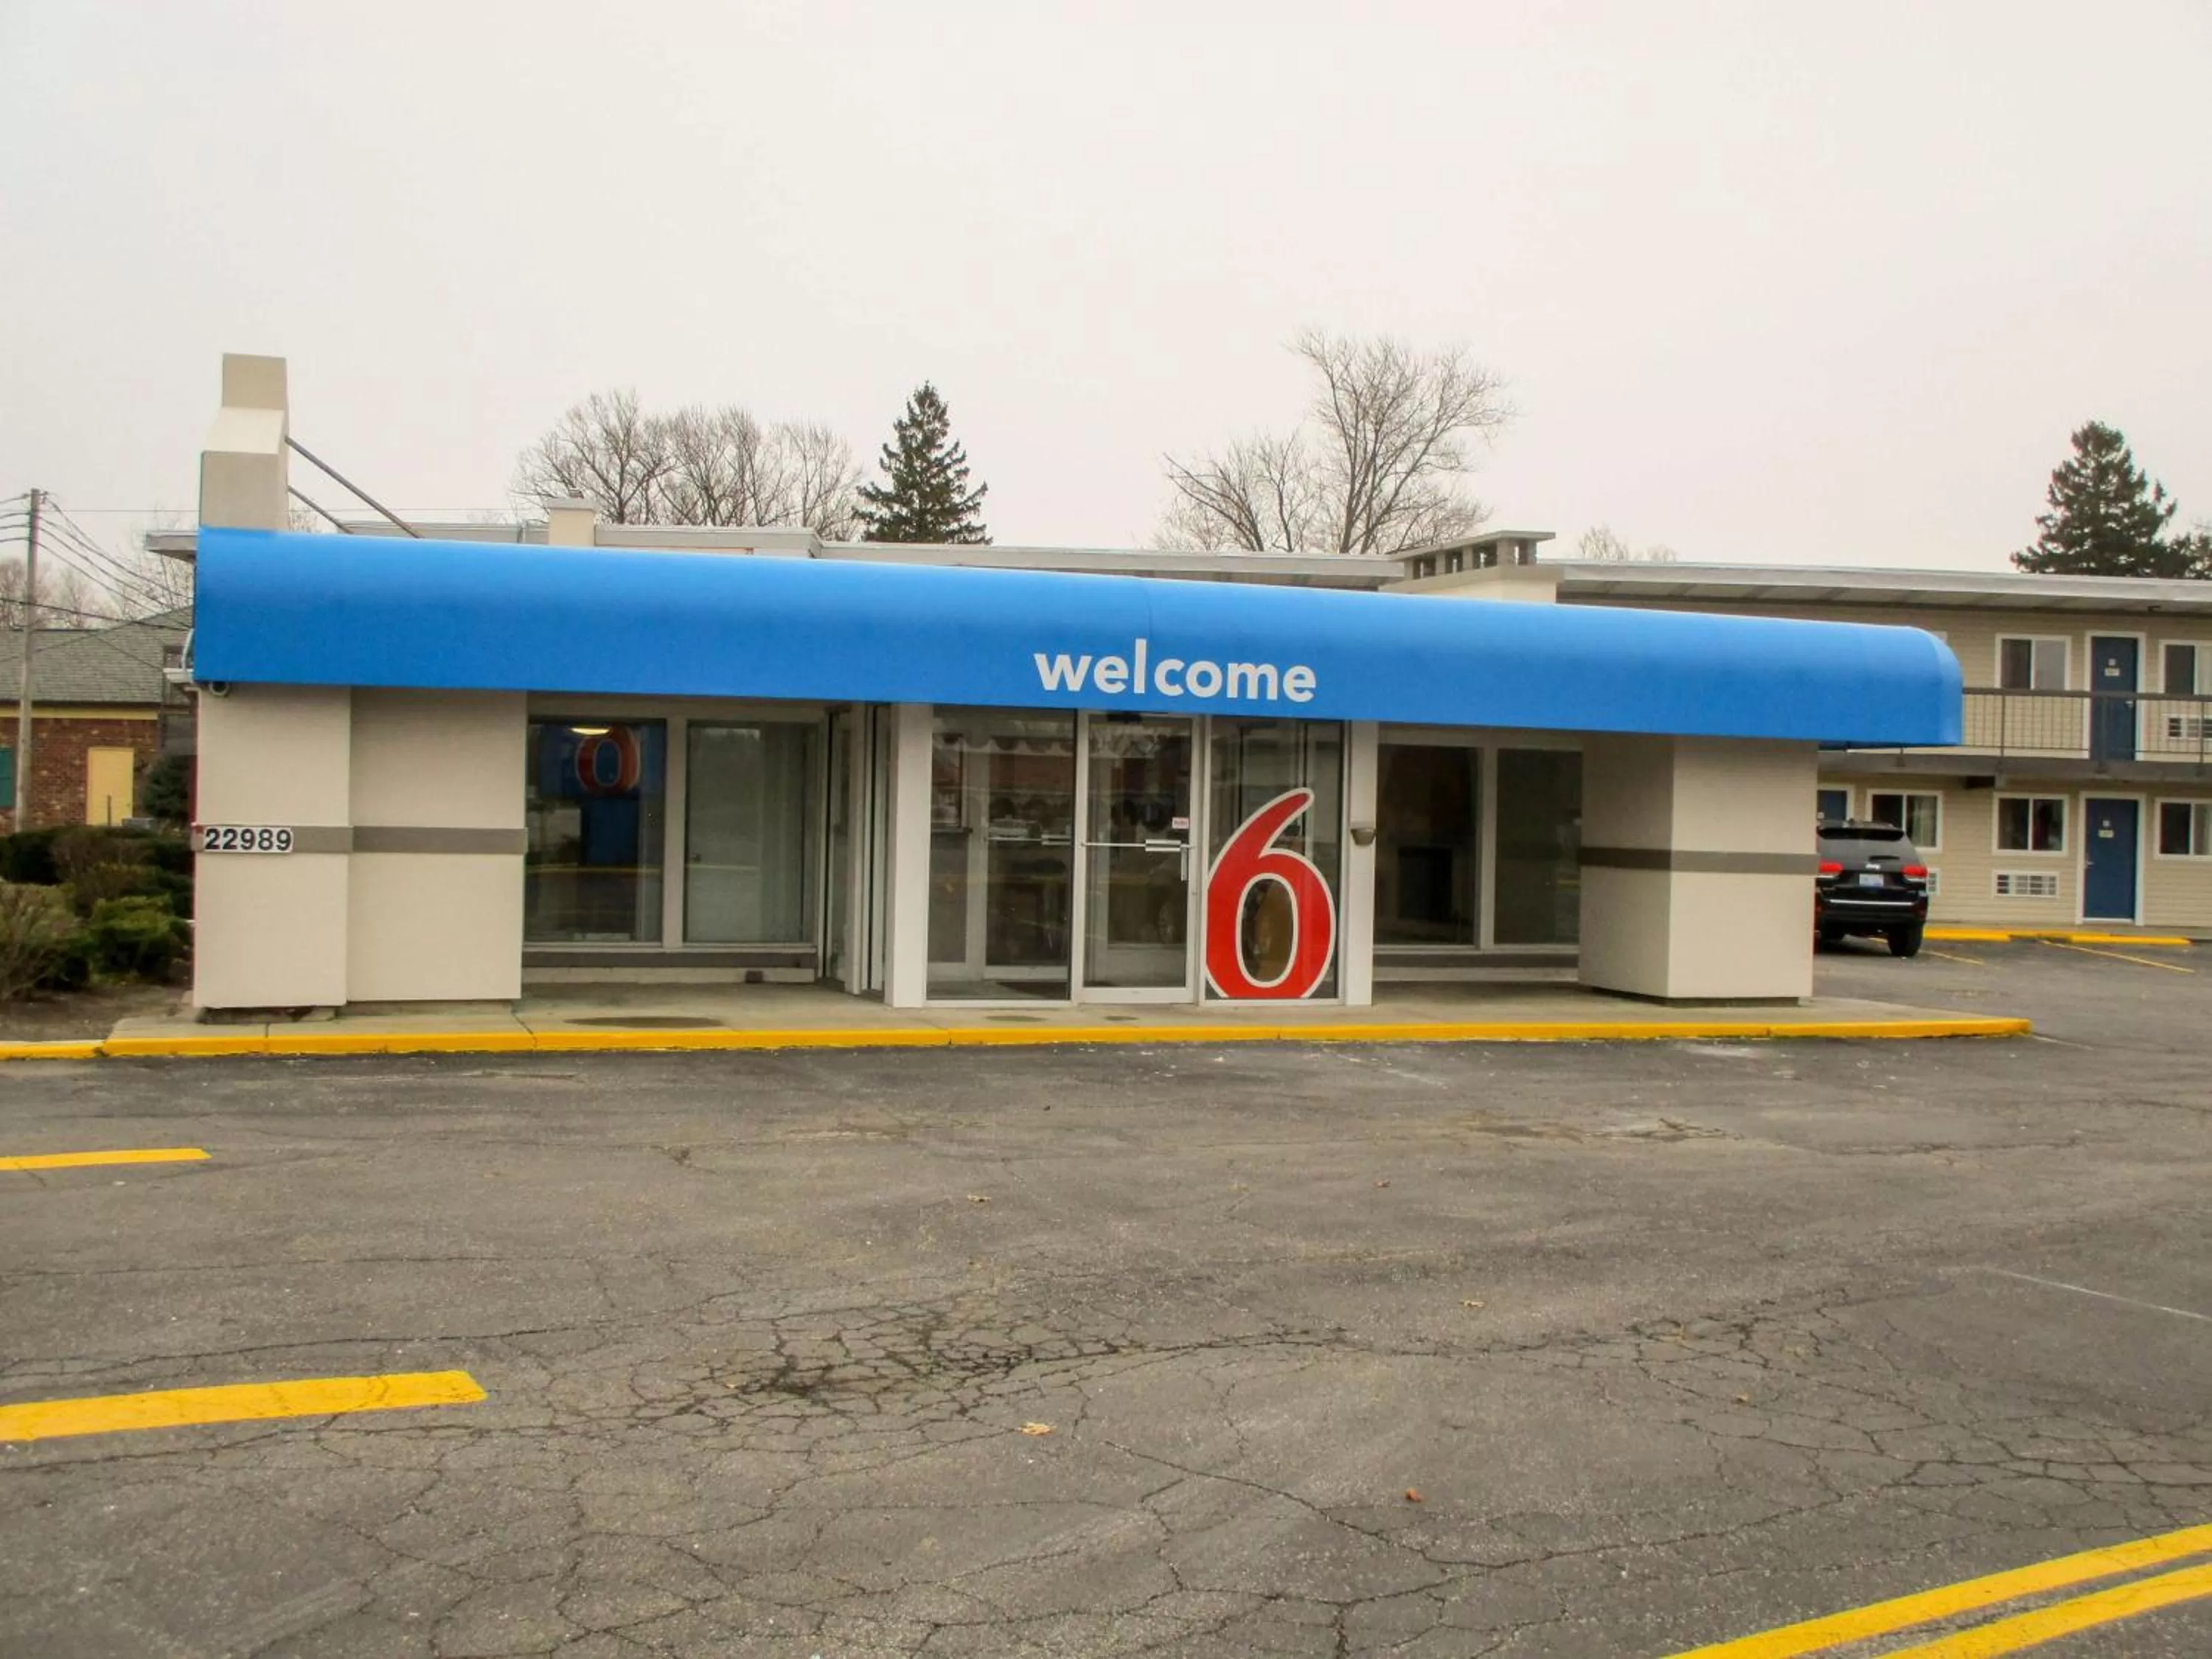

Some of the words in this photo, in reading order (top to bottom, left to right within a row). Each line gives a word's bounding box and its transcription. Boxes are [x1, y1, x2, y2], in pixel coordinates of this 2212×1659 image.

[1034, 638, 1316, 702] welcome
[205, 828, 291, 851] 22989
[1206, 787, 1336, 999] 6
